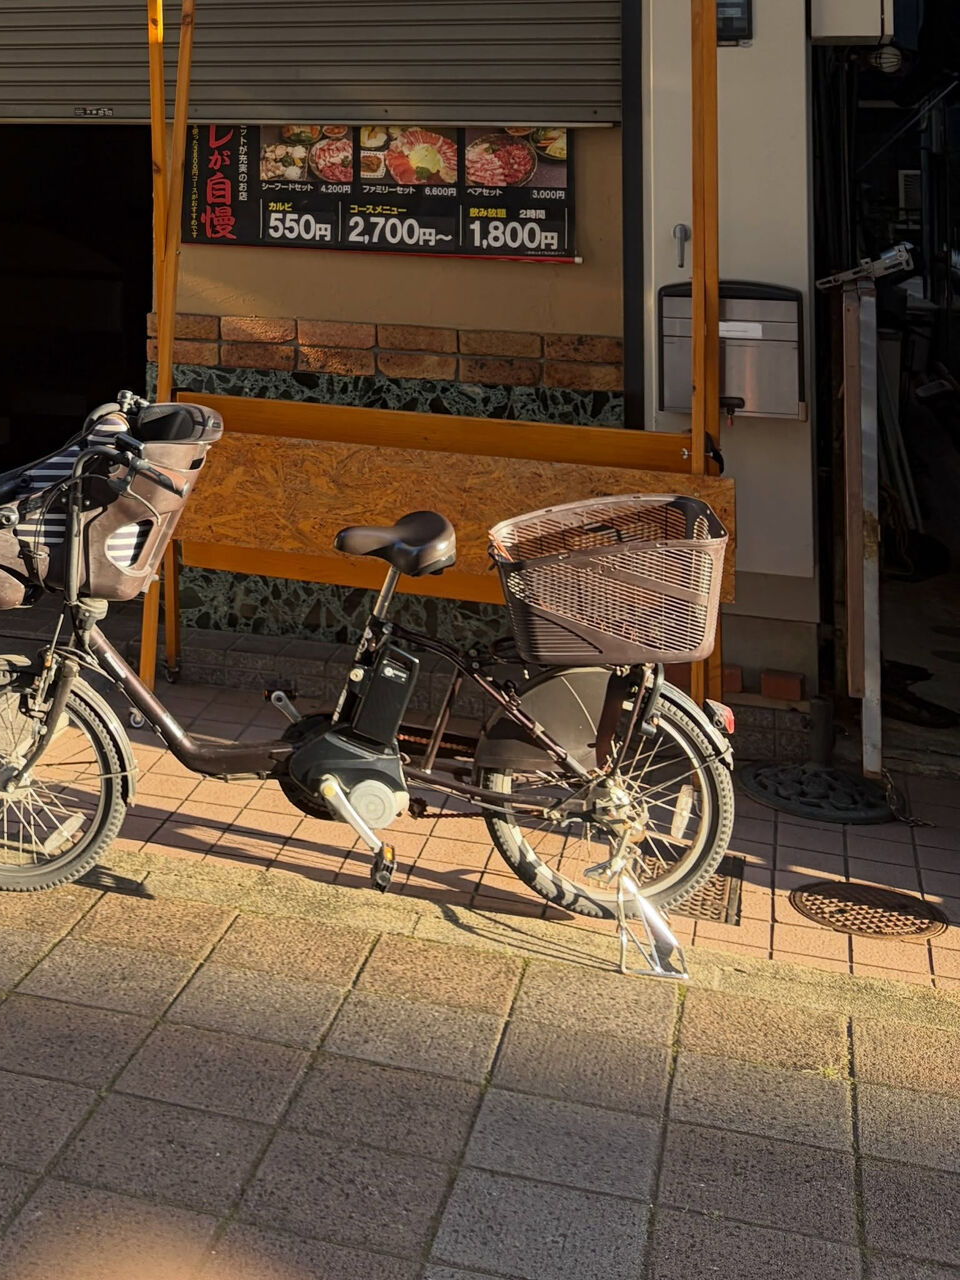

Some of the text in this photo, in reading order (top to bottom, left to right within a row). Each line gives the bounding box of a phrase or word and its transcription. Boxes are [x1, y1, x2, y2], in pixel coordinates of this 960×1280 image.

[239, 125, 248, 201] ットが充実のお店
[261, 183, 314, 192] シーフードセット
[362, 185, 416, 194] ファミリーセット
[466, 187, 503, 197] ペアセット
[268, 202, 292, 212] カルビ
[349, 204, 407, 215] コースメニュー
[469, 208, 546, 220] 飲み放題 2時間
[268, 212, 332, 241] 550円
[469, 220, 559, 250] 1,800円
